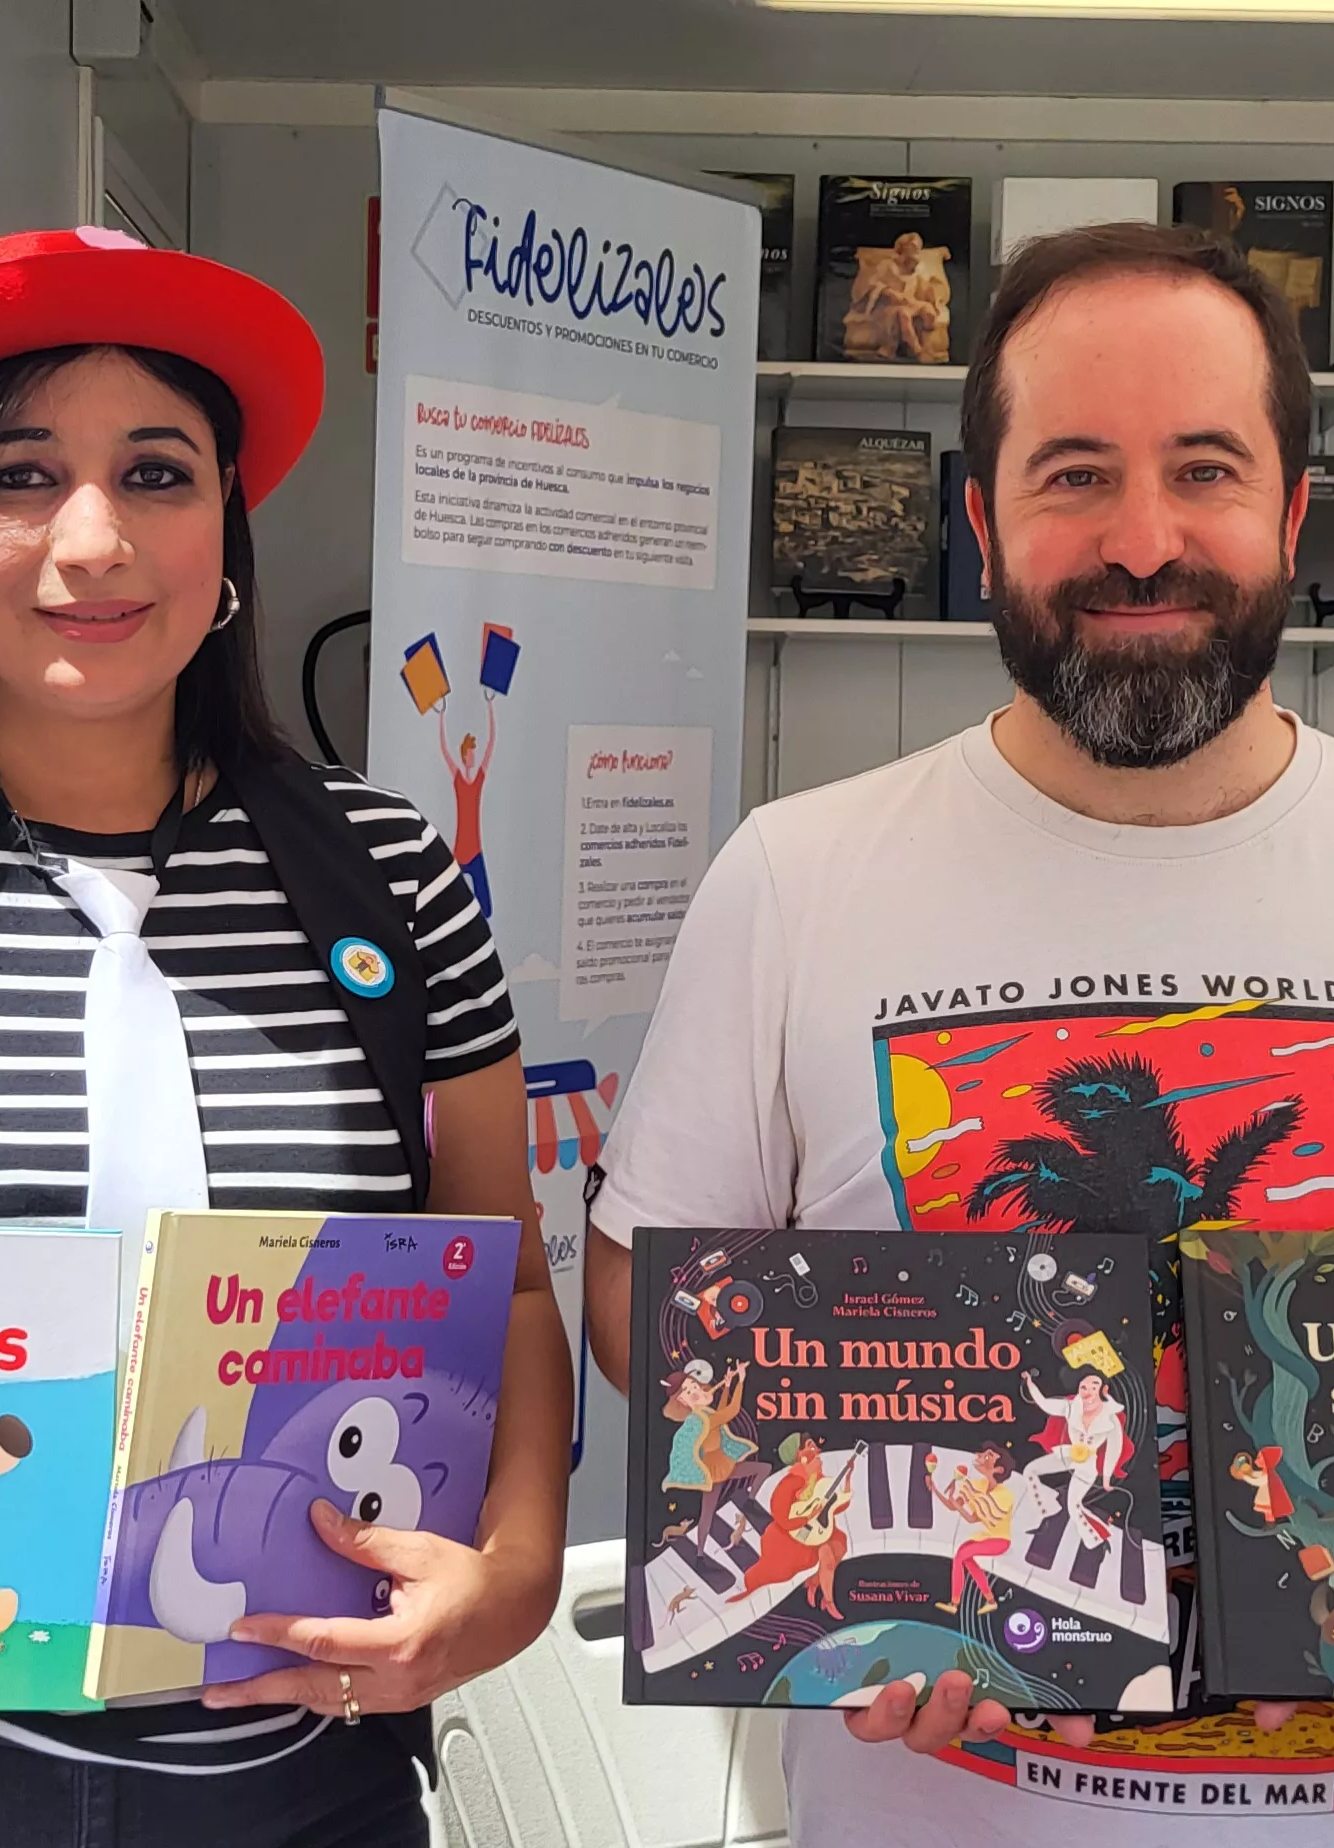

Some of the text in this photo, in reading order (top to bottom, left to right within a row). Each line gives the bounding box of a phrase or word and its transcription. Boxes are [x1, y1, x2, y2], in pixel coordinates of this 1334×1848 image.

[869, 181, 932, 205] Signos
[1254, 195, 1326, 211] SIGNOS
[761, 247, 788, 260] nos
[453, 198, 727, 338] Fidelizales
[467, 308, 718, 370] DESCUENTOS Y PROMOCIONES EN TU COMERCIO
[417, 402, 450, 427] Busca
[454, 405, 467, 431] tu
[471, 414, 528, 438] comercio
[859, 437, 925, 451] ALQUÉZAR
[415, 445, 427, 458] Es
[430, 449, 443, 461] un
[447, 451, 493, 466] programa
[495, 456, 505, 468] de
[415, 462, 570, 494] locales de la provincia de Huesca.
[415, 490, 436, 504] Esta
[438, 492, 481, 509] iniciativa
[414, 508, 427, 521] de
[413, 527, 441, 541] bolso
[442, 531, 465, 544] para
[873, 981, 1025, 1021] JAVATO
[1048, 973, 1178, 1000] JONES
[258, 1235, 341, 1249] Mariela Cisneros
[206, 1271, 451, 1326] Un elefante
[843, 1292, 925, 1305] Israel Gómez
[832, 1305, 937, 1318] Mariela Cisneros
[218, 1333, 425, 1387] caminaba
[749, 1327, 1022, 1371] Un mundo
[118, 1286, 149, 1453] Un elefante caminaba
[755, 1377, 1017, 1423] sin música
[849, 1589, 930, 1603] Susana Vivar
[1051, 1617, 1081, 1630] Hola
[1051, 1630, 1113, 1642] monstruo
[1027, 1761, 1327, 1806] EN FRENTE DEL MAR
